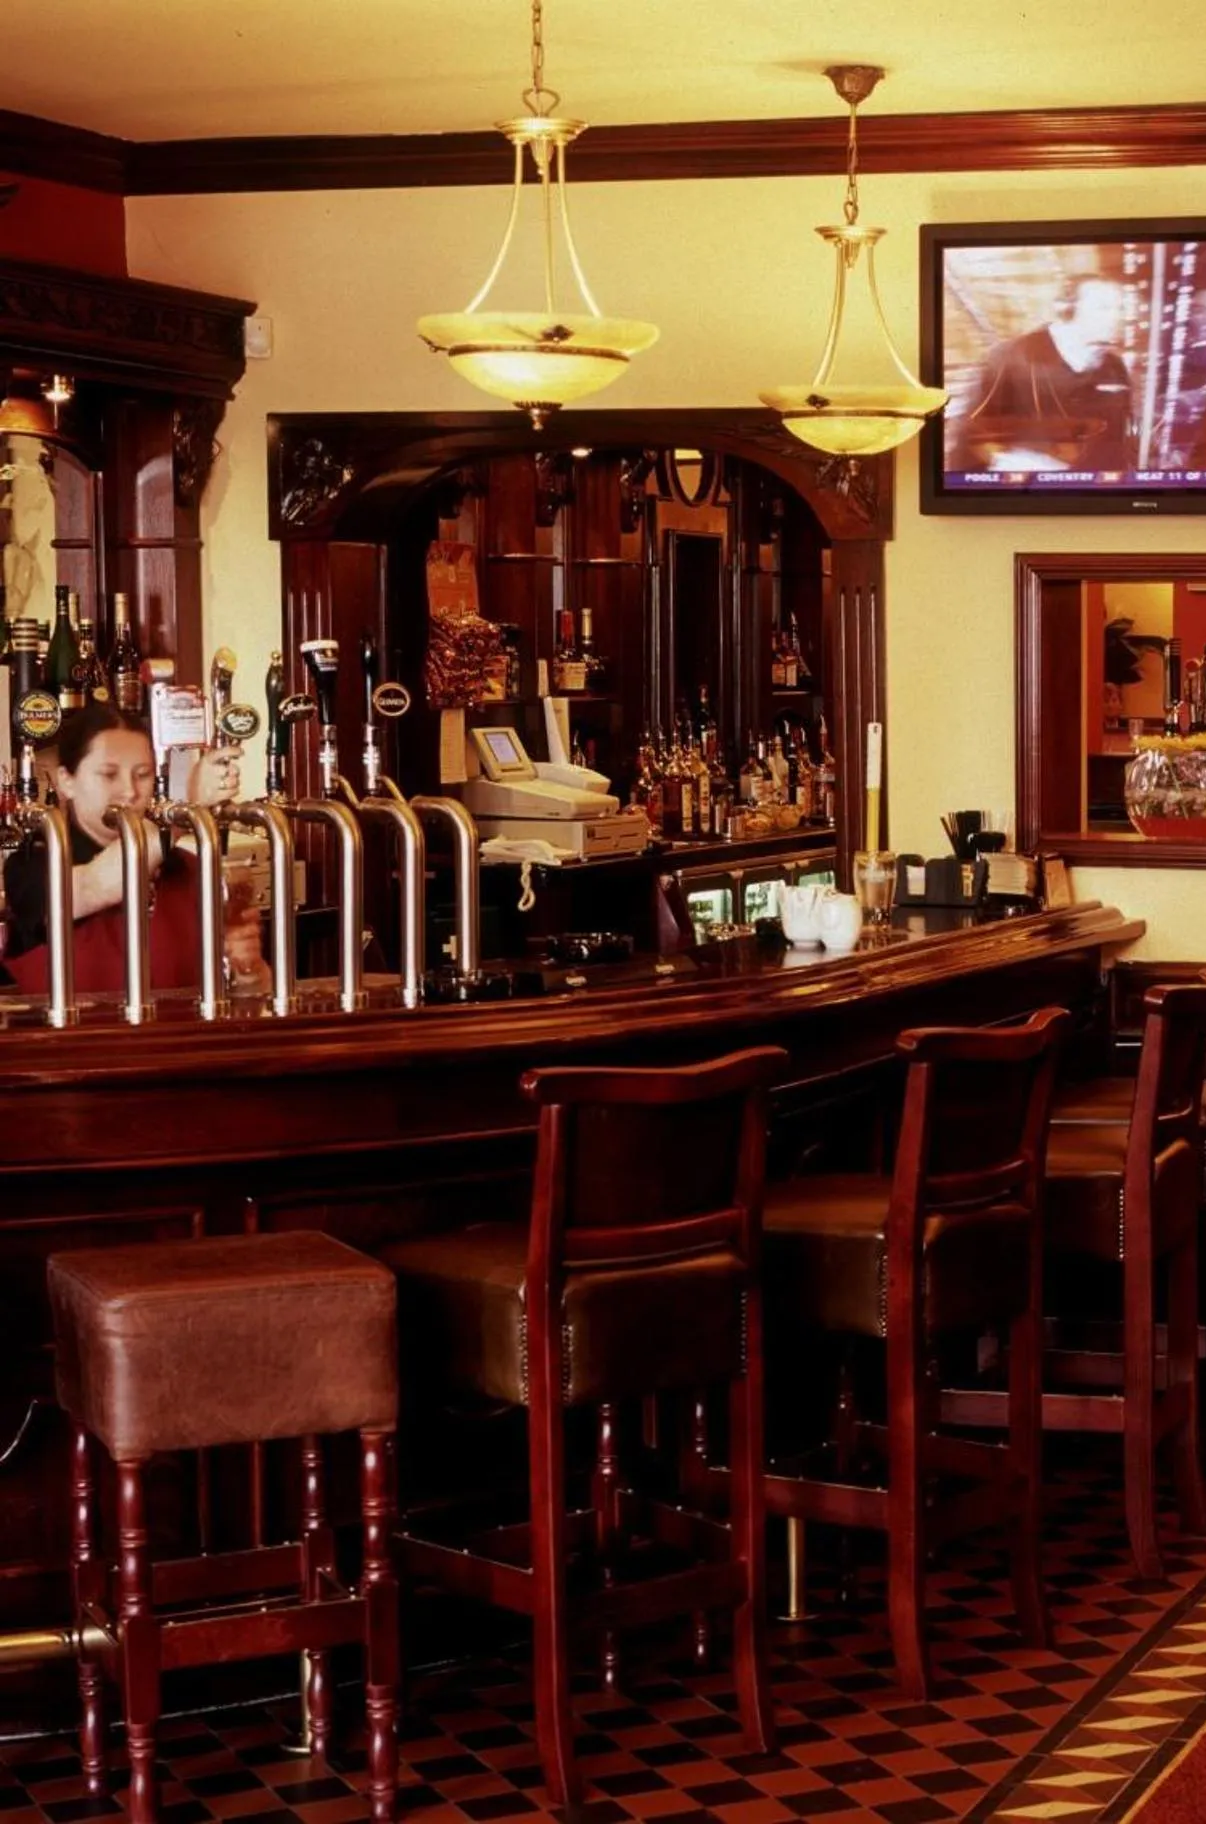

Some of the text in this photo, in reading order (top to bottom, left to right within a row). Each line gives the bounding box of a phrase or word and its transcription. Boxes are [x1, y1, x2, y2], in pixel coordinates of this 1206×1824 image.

[964, 473, 999, 482] POOLE
[1037, 472, 1095, 482] COVENTRY
[1135, 471, 1164, 481] HEAT
[1169, 471, 1182, 481] 11
[1185, 471, 1201, 481] OF
